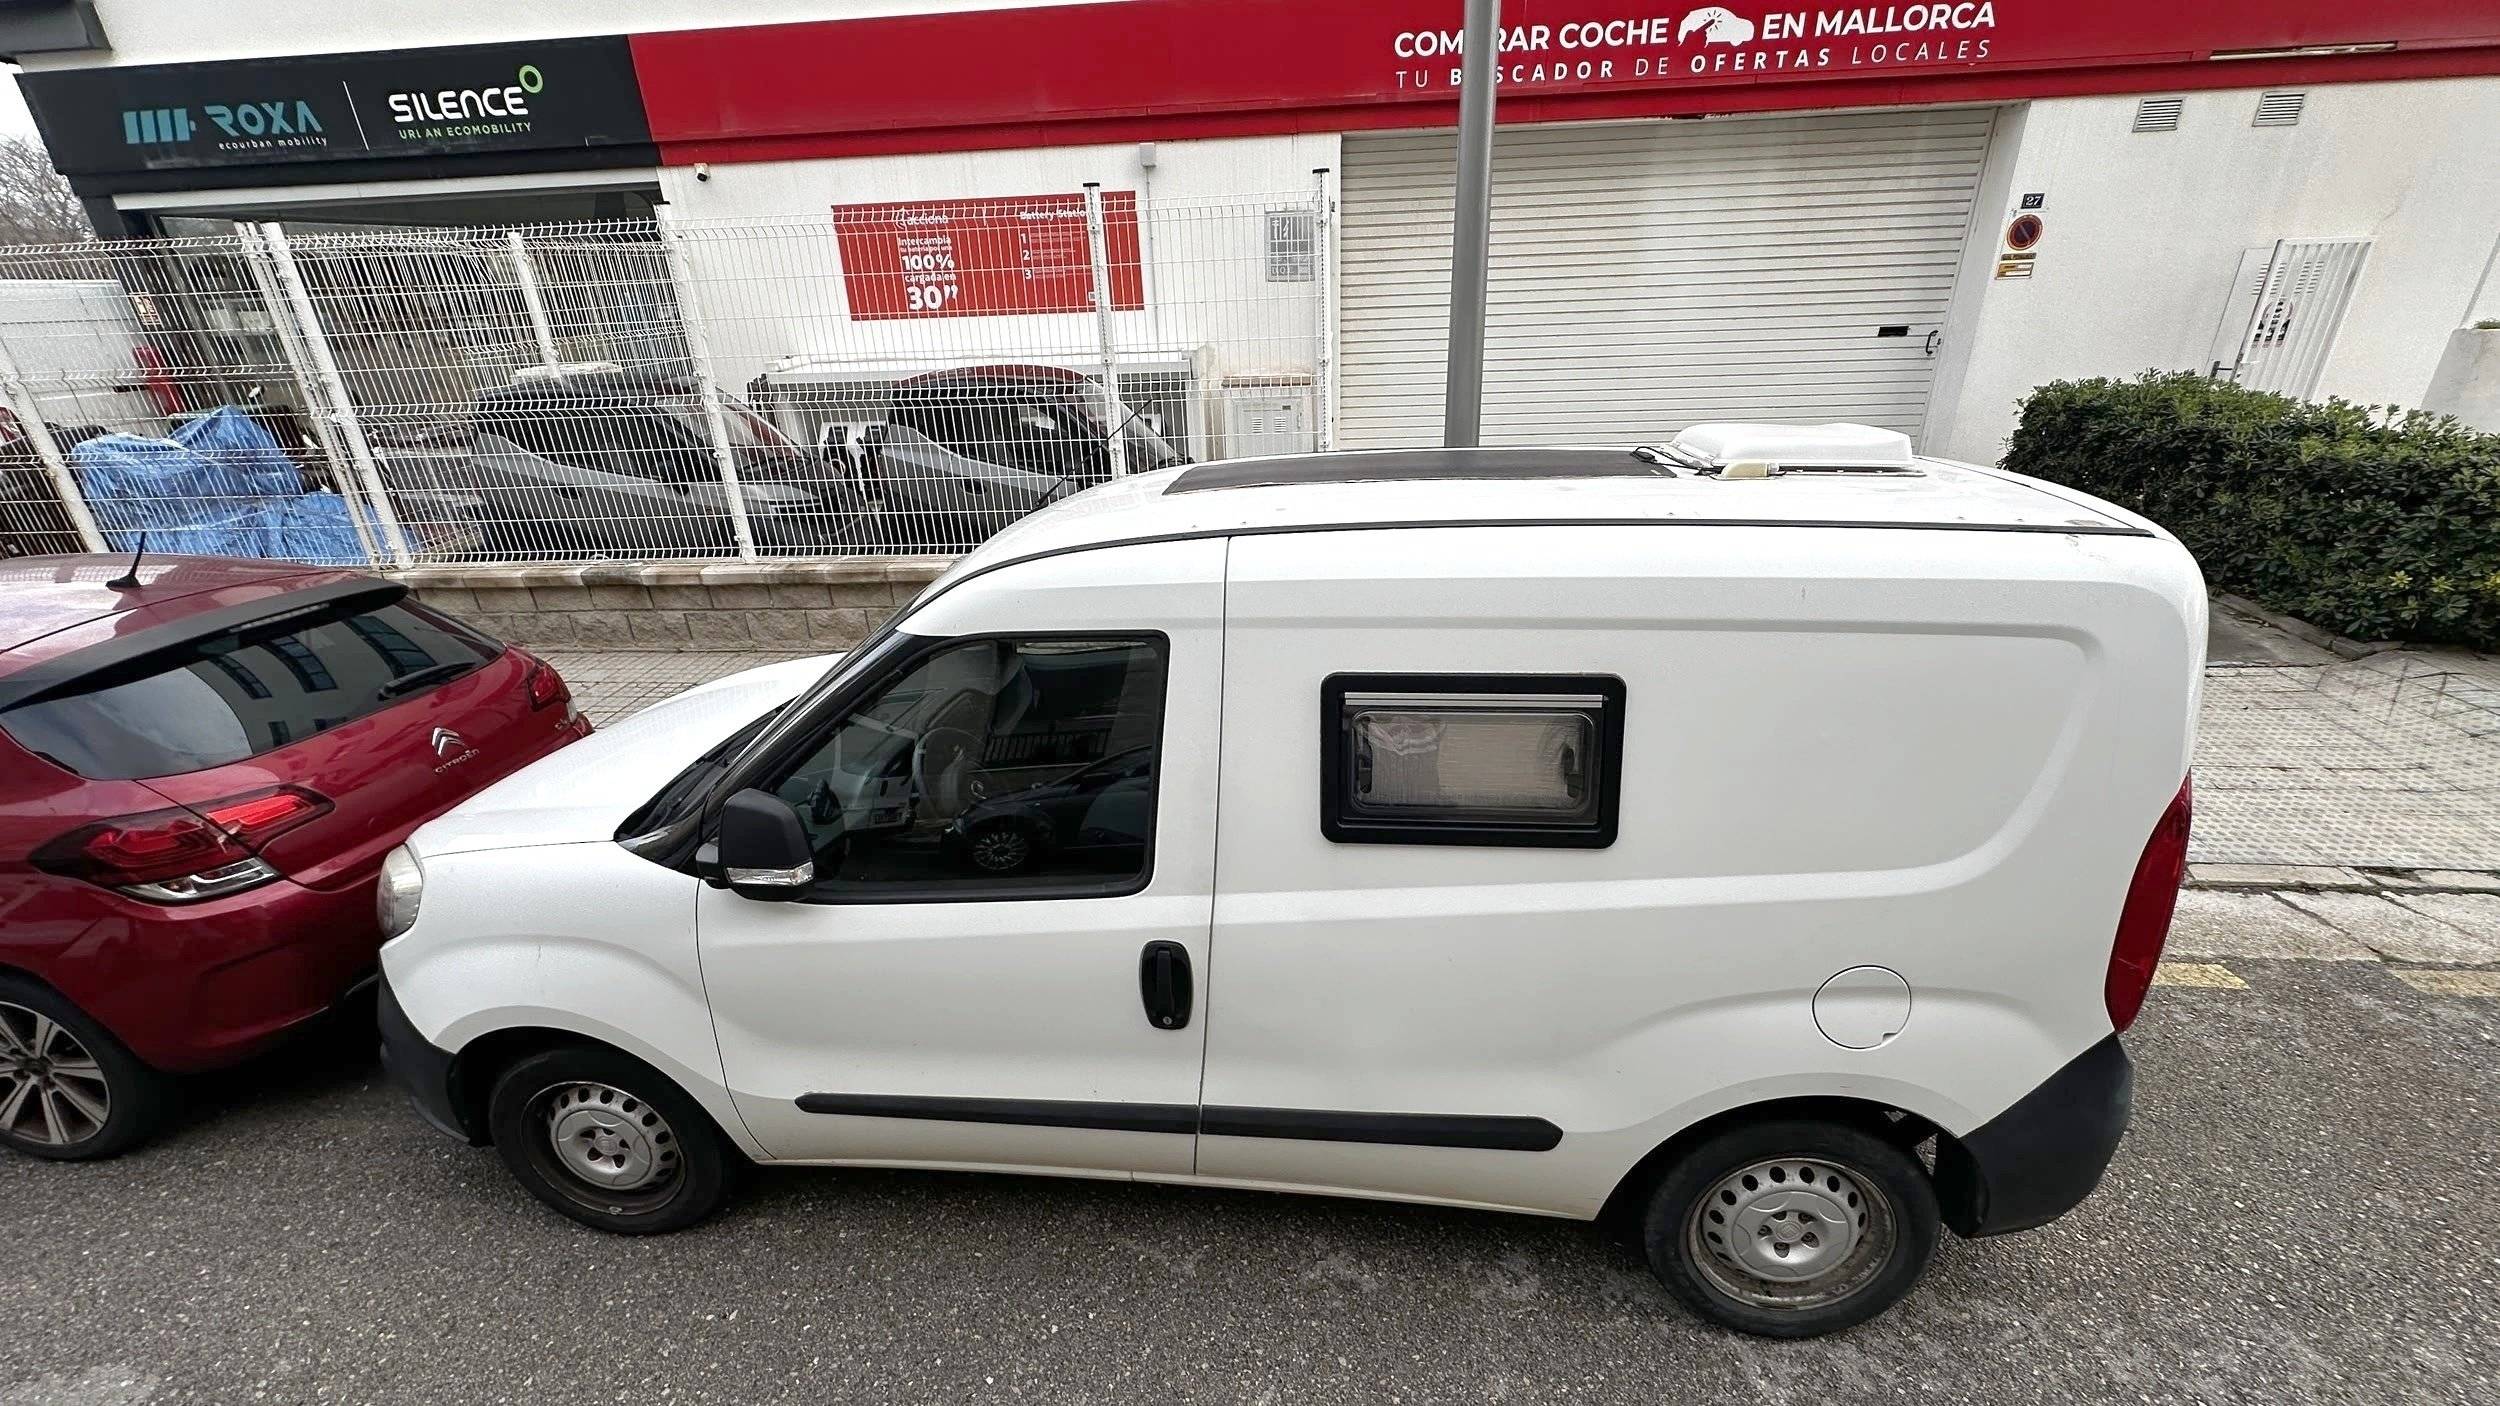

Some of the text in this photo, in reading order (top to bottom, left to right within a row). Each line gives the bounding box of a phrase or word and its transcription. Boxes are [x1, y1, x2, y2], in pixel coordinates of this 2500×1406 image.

[1394, 1, 1996, 57] COMAR COCHE EN MALLORCA
[1395, 39, 1990, 89] TU BSCADOR DE OFERTAS LOCALES
[388, 86, 528, 122] SILENCE
[204, 100, 323, 137] ROXA
[446, 122, 531, 137] ECOMOBILITY
[218, 136, 327, 150] ecourban mobility
[2025, 195, 2042, 206] 27
[1057, 208, 1087, 218] Statio
[1020, 233, 1027, 244] 1
[902, 253, 955, 271] 100%
[1022, 250, 1031, 260] 2
[1025, 269, 1032, 280] 3
